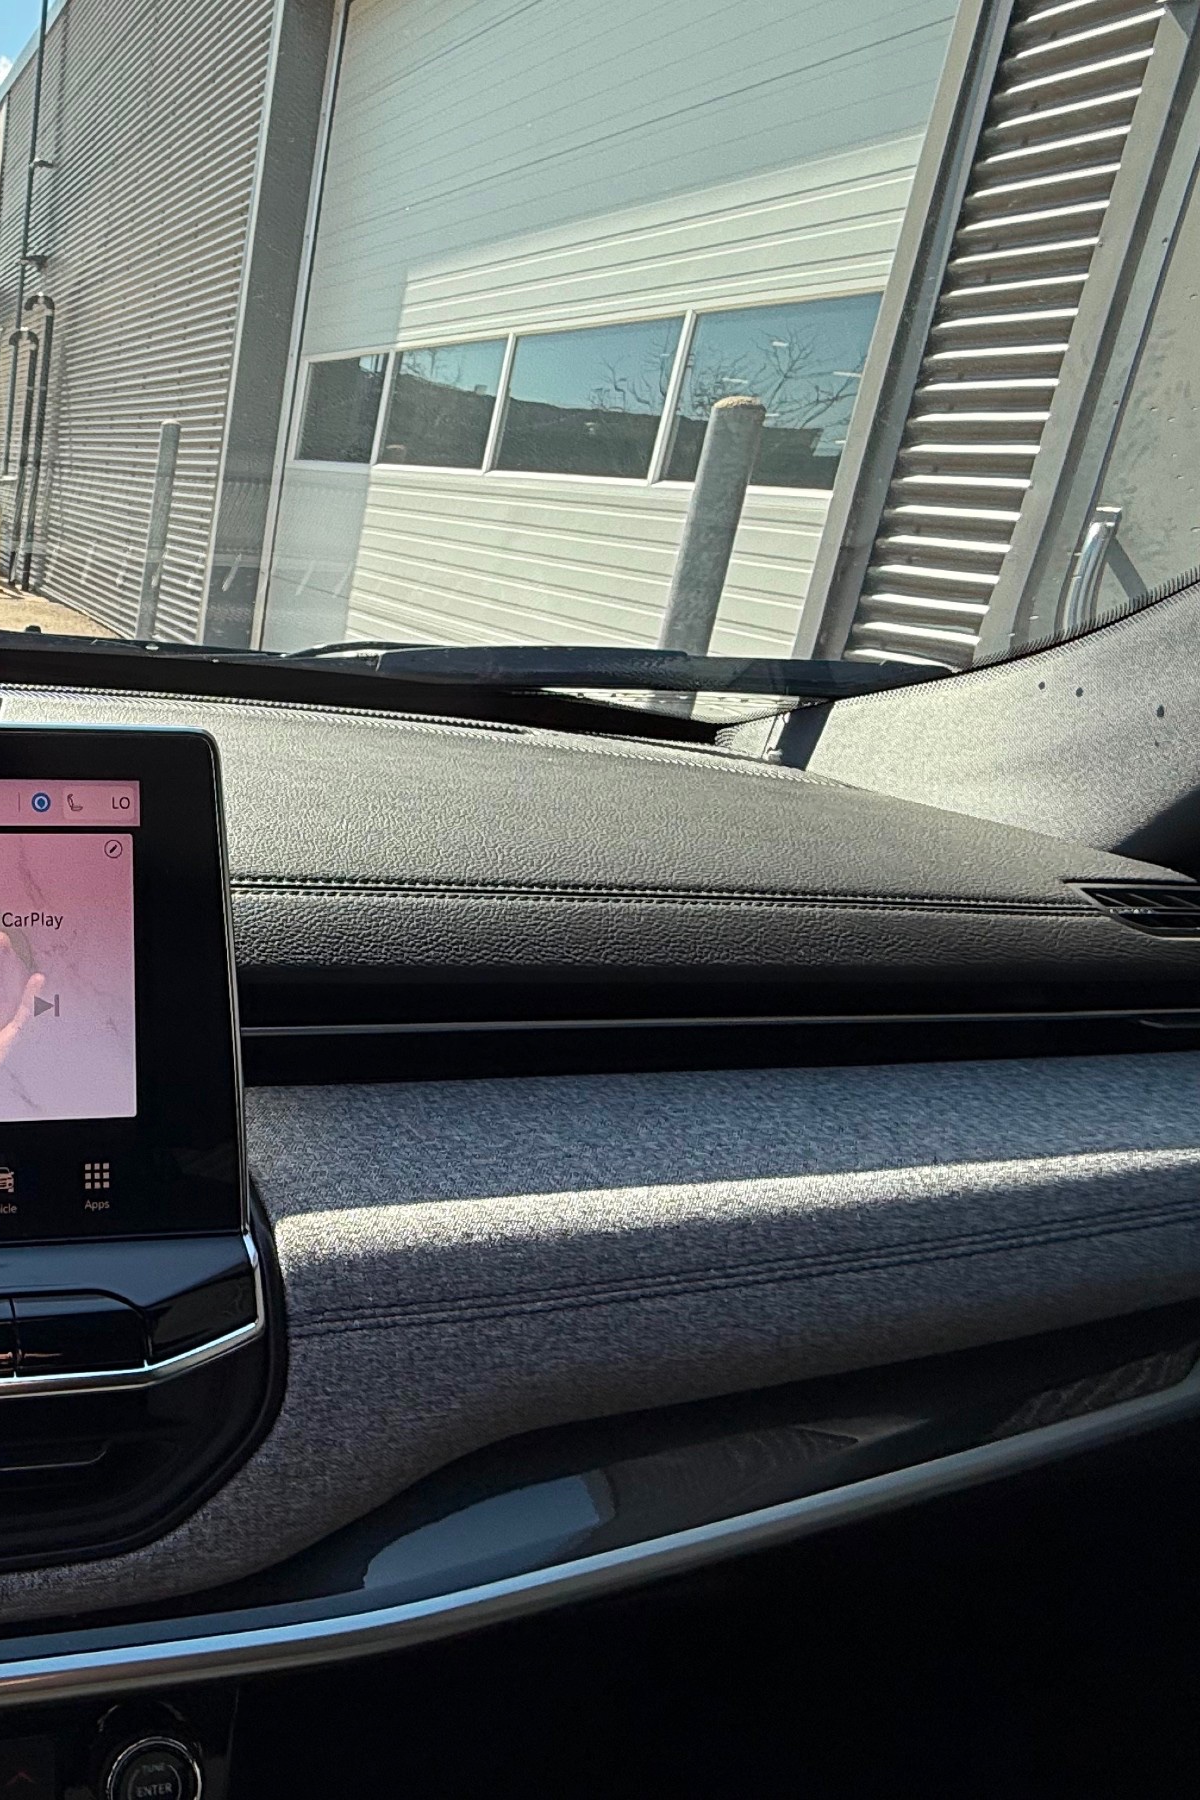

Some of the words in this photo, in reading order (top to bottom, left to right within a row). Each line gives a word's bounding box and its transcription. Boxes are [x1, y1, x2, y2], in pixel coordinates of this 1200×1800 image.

[111, 796, 131, 810] LO
[1, 911, 64, 931] CarPlay
[84, 1199, 111, 1212] Apps
[136, 1782, 173, 1798] ENTER
